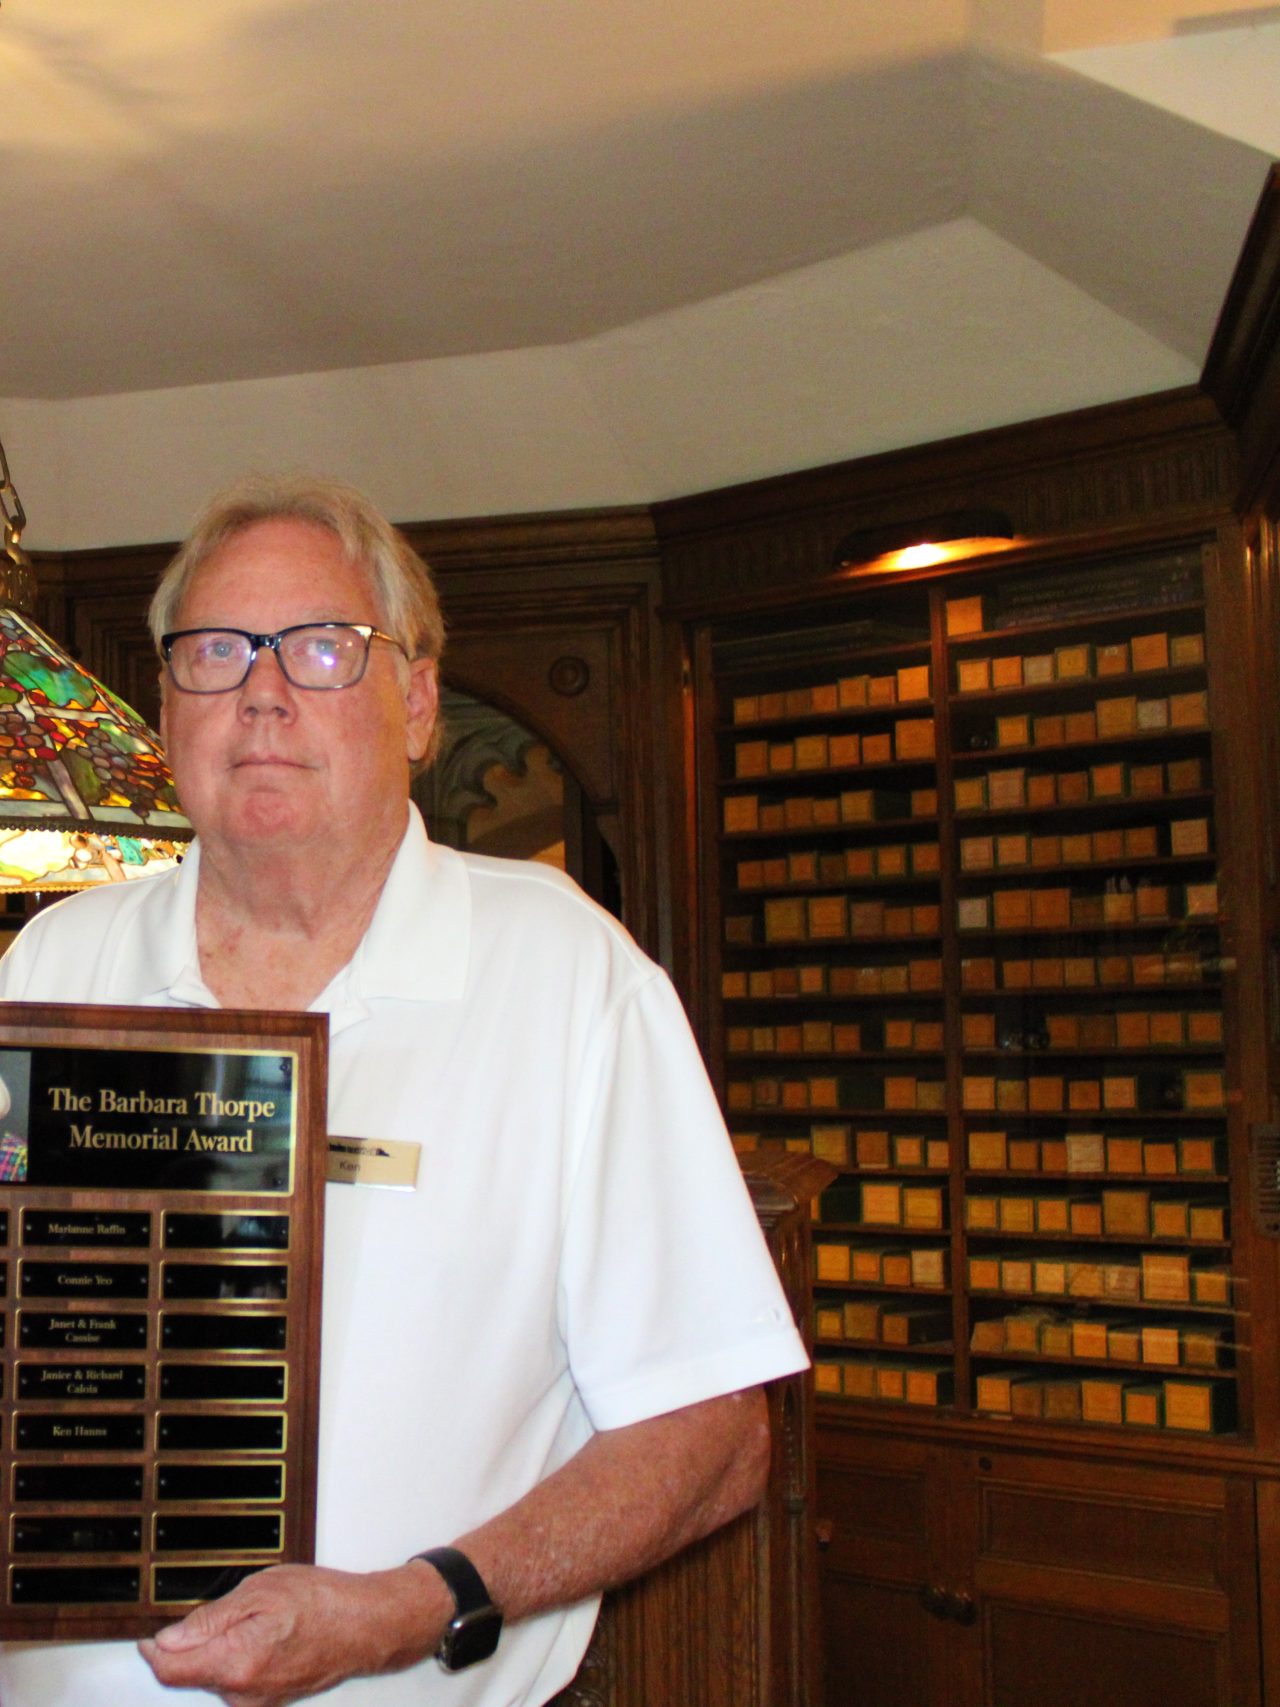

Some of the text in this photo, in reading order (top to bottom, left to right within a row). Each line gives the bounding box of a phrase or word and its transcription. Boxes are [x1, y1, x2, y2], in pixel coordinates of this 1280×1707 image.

[48, 1087, 276, 1123] The Barbara Thorpe
[69, 1124, 254, 1152] Memorial Award
[48, 1223, 94, 1234] Marianne
[57, 1275, 93, 1285] Connie
[48, 1319, 117, 1330] Janet & Frank
[41, 1370, 124, 1381] Janice & Richard
[52, 1426, 73, 1437] Ken
